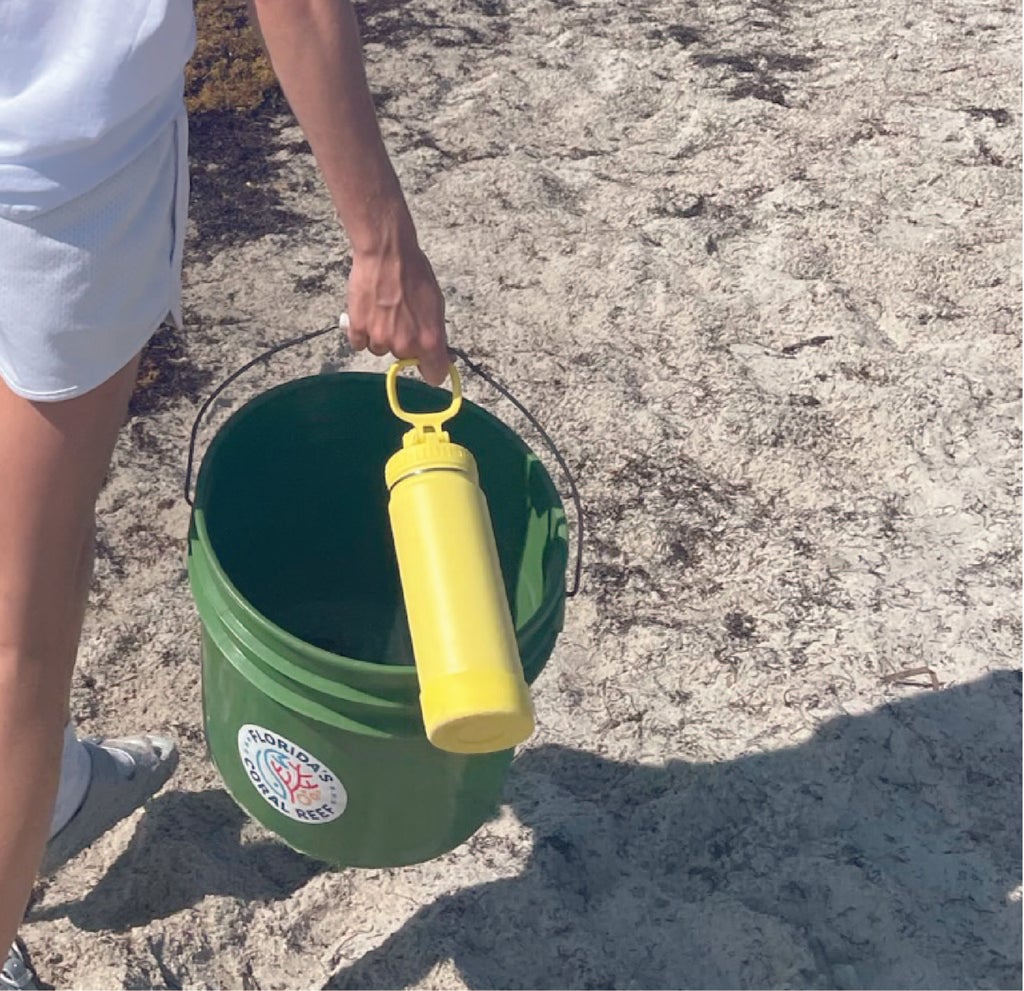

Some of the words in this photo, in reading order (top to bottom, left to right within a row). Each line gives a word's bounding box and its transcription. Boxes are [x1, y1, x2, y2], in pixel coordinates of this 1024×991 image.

[248, 729, 334, 783] FLORIDA'S
[243, 757, 290, 814] CORAL
[295, 803, 335, 821] REEF
